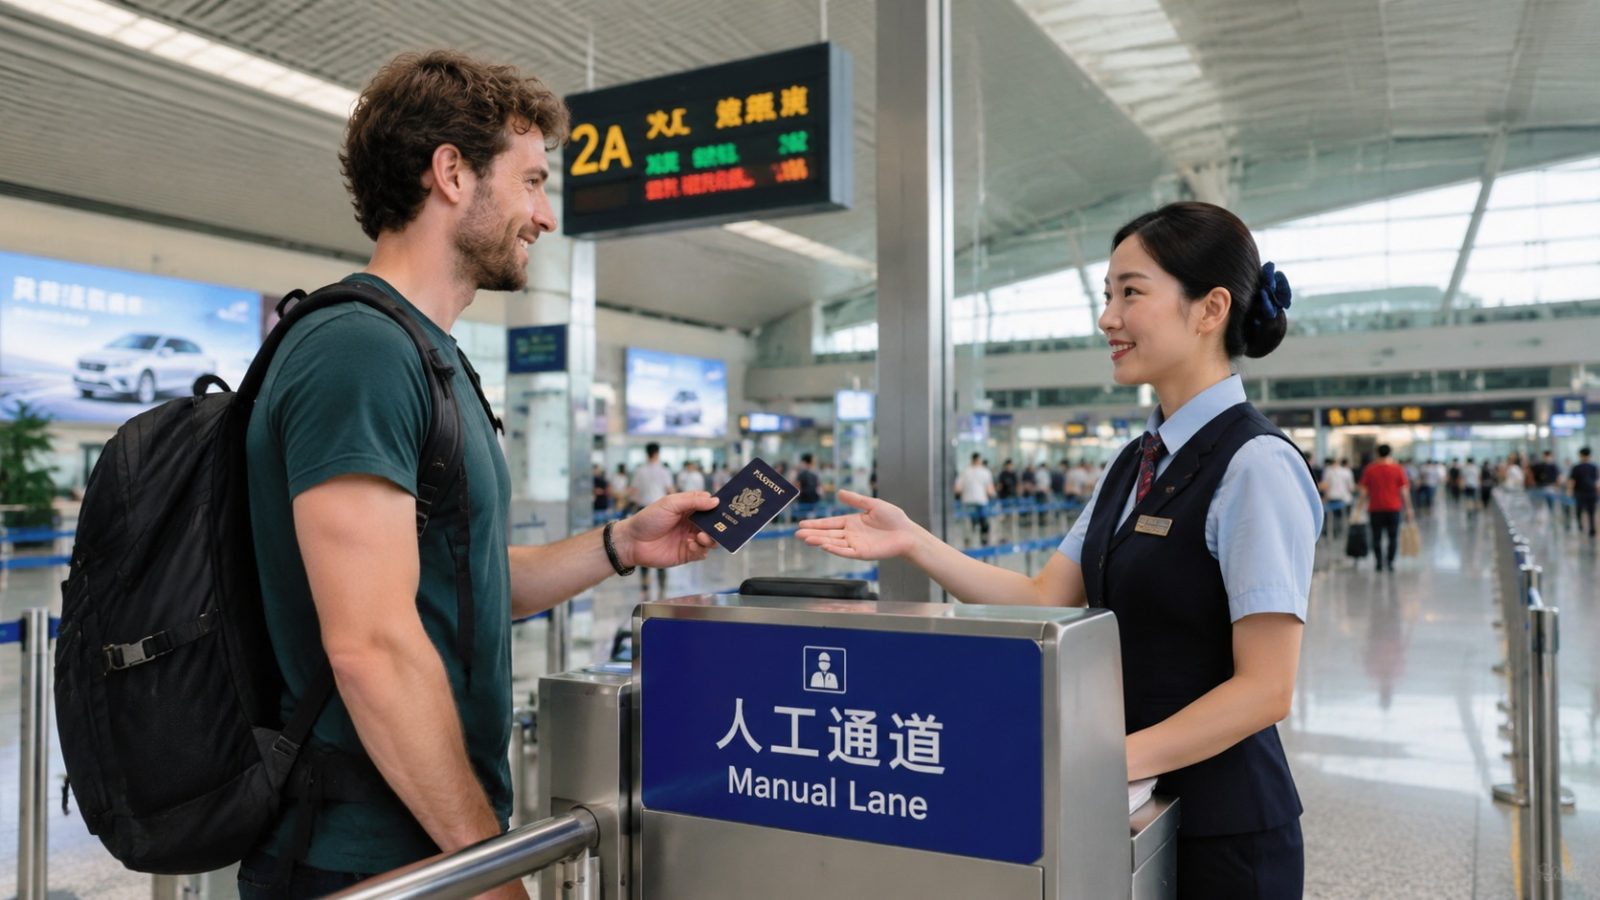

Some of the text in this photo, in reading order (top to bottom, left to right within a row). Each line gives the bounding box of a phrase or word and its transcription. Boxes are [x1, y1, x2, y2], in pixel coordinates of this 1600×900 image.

[570, 122, 633, 176] 2A
[716, 697, 945, 775] 人工通道
[728, 765, 928, 820] Manual Lane
